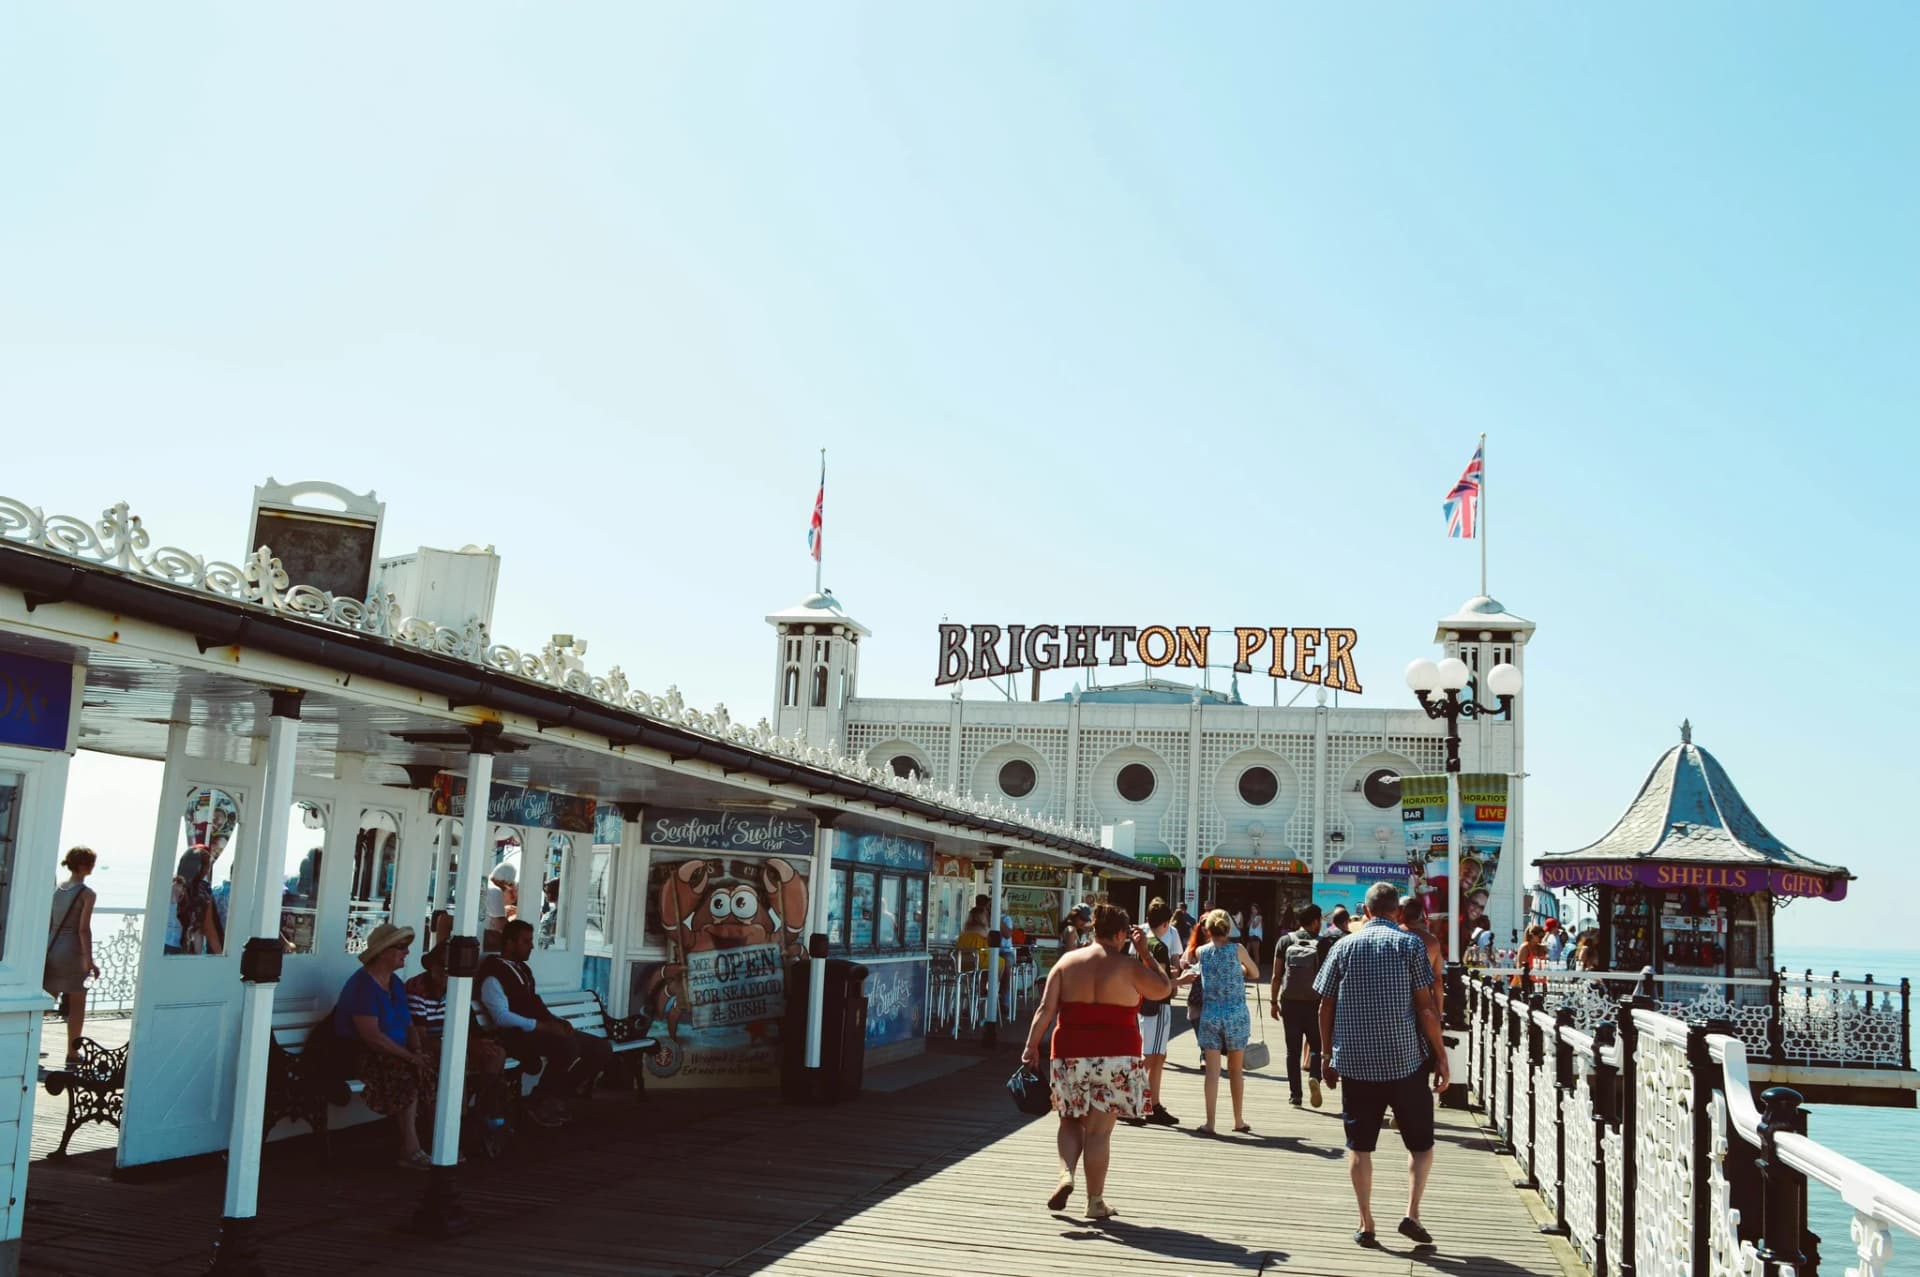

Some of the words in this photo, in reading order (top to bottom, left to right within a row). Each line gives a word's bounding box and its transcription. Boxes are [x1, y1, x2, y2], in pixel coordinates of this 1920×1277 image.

[935, 624, 1210, 686] BRIGHTON
[1234, 627, 1362, 694] PIER
[488, 788, 525, 818] eafood
[1403, 795, 1445, 805] HORATIO'S
[1463, 794, 1506, 802] HORATIO'S
[1404, 811, 1421, 819] BAR
[1479, 808, 1505, 819] LIVE
[651, 812, 727, 844] Seafood
[732, 815, 784, 845] Sushi
[762, 840, 785, 850] Bar
[1338, 865, 1357, 873] WHERE
[1361, 865, 1386, 874] TICKETS
[1388, 867, 1406, 875] MAKE
[1543, 865, 1633, 882] SOUVENIRS
[1657, 865, 1747, 887] SHELLS
[1782, 873, 1823, 894] GIFTS
[714, 946, 776, 983] OPEN
[694, 988, 719, 1006] FOR
[722, 980, 780, 1001] SEAFOOD
[728, 999, 766, 1020] SUSHI
